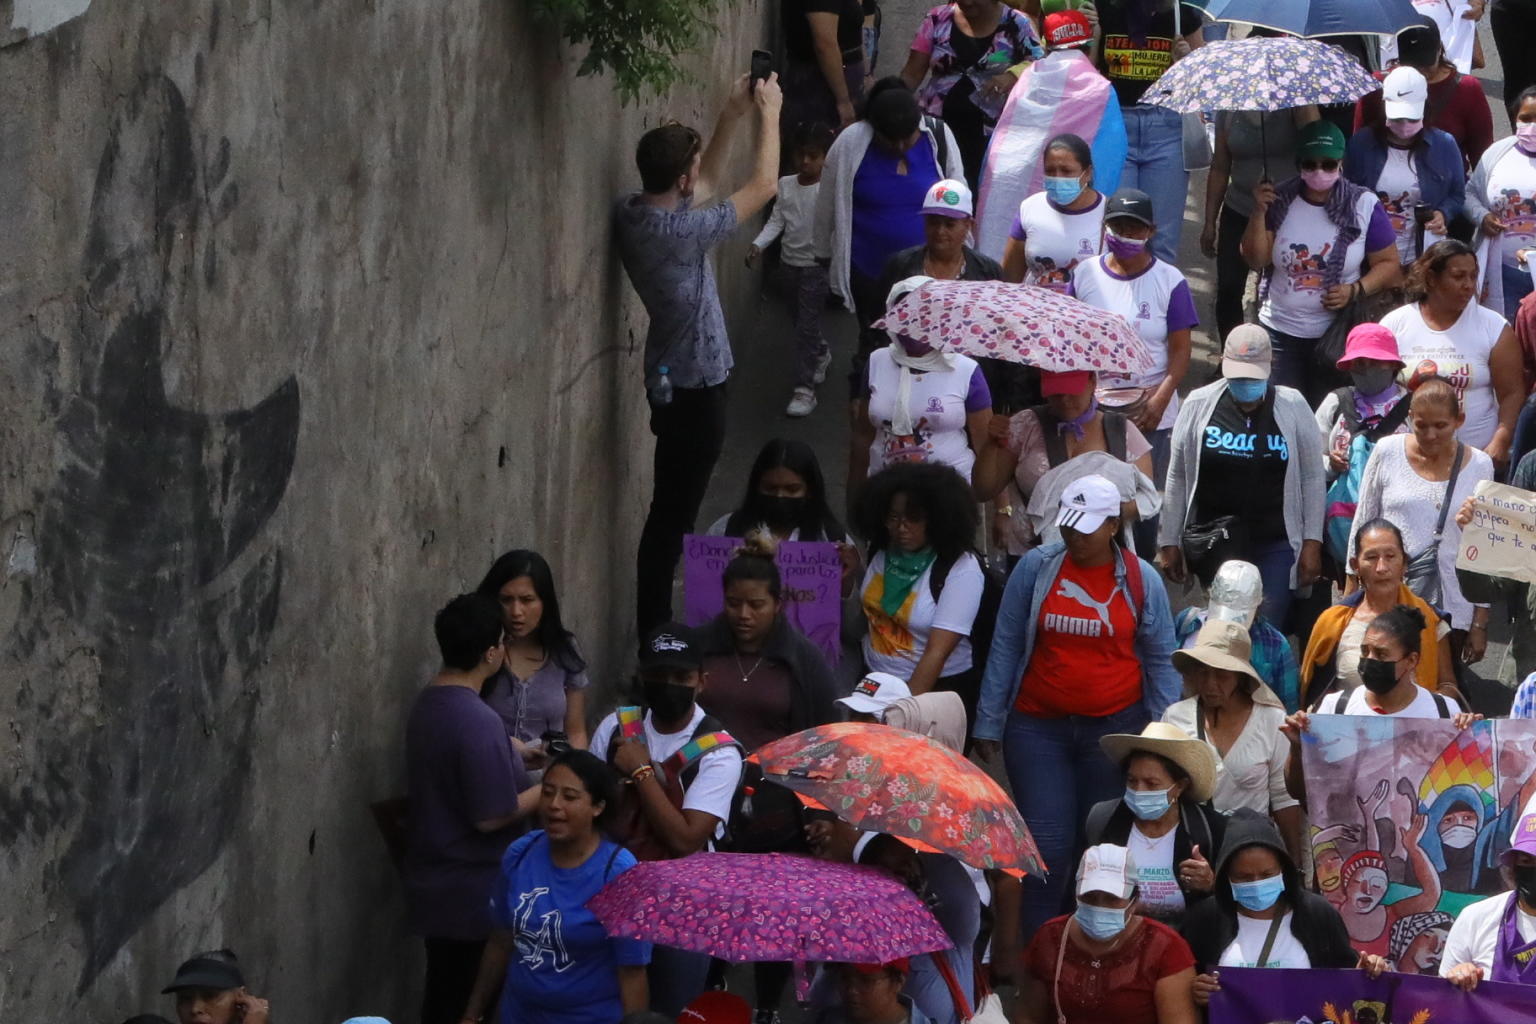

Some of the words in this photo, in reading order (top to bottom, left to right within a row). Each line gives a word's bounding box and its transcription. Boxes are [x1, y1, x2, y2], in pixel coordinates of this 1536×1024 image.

[1493, 498, 1525, 512] mano
[1475, 510, 1510, 530] golpea
[1521, 522, 1535, 533] no
[1487, 532, 1505, 547] que
[1512, 533, 1524, 548] te
[1044, 613, 1101, 637] PUMA
